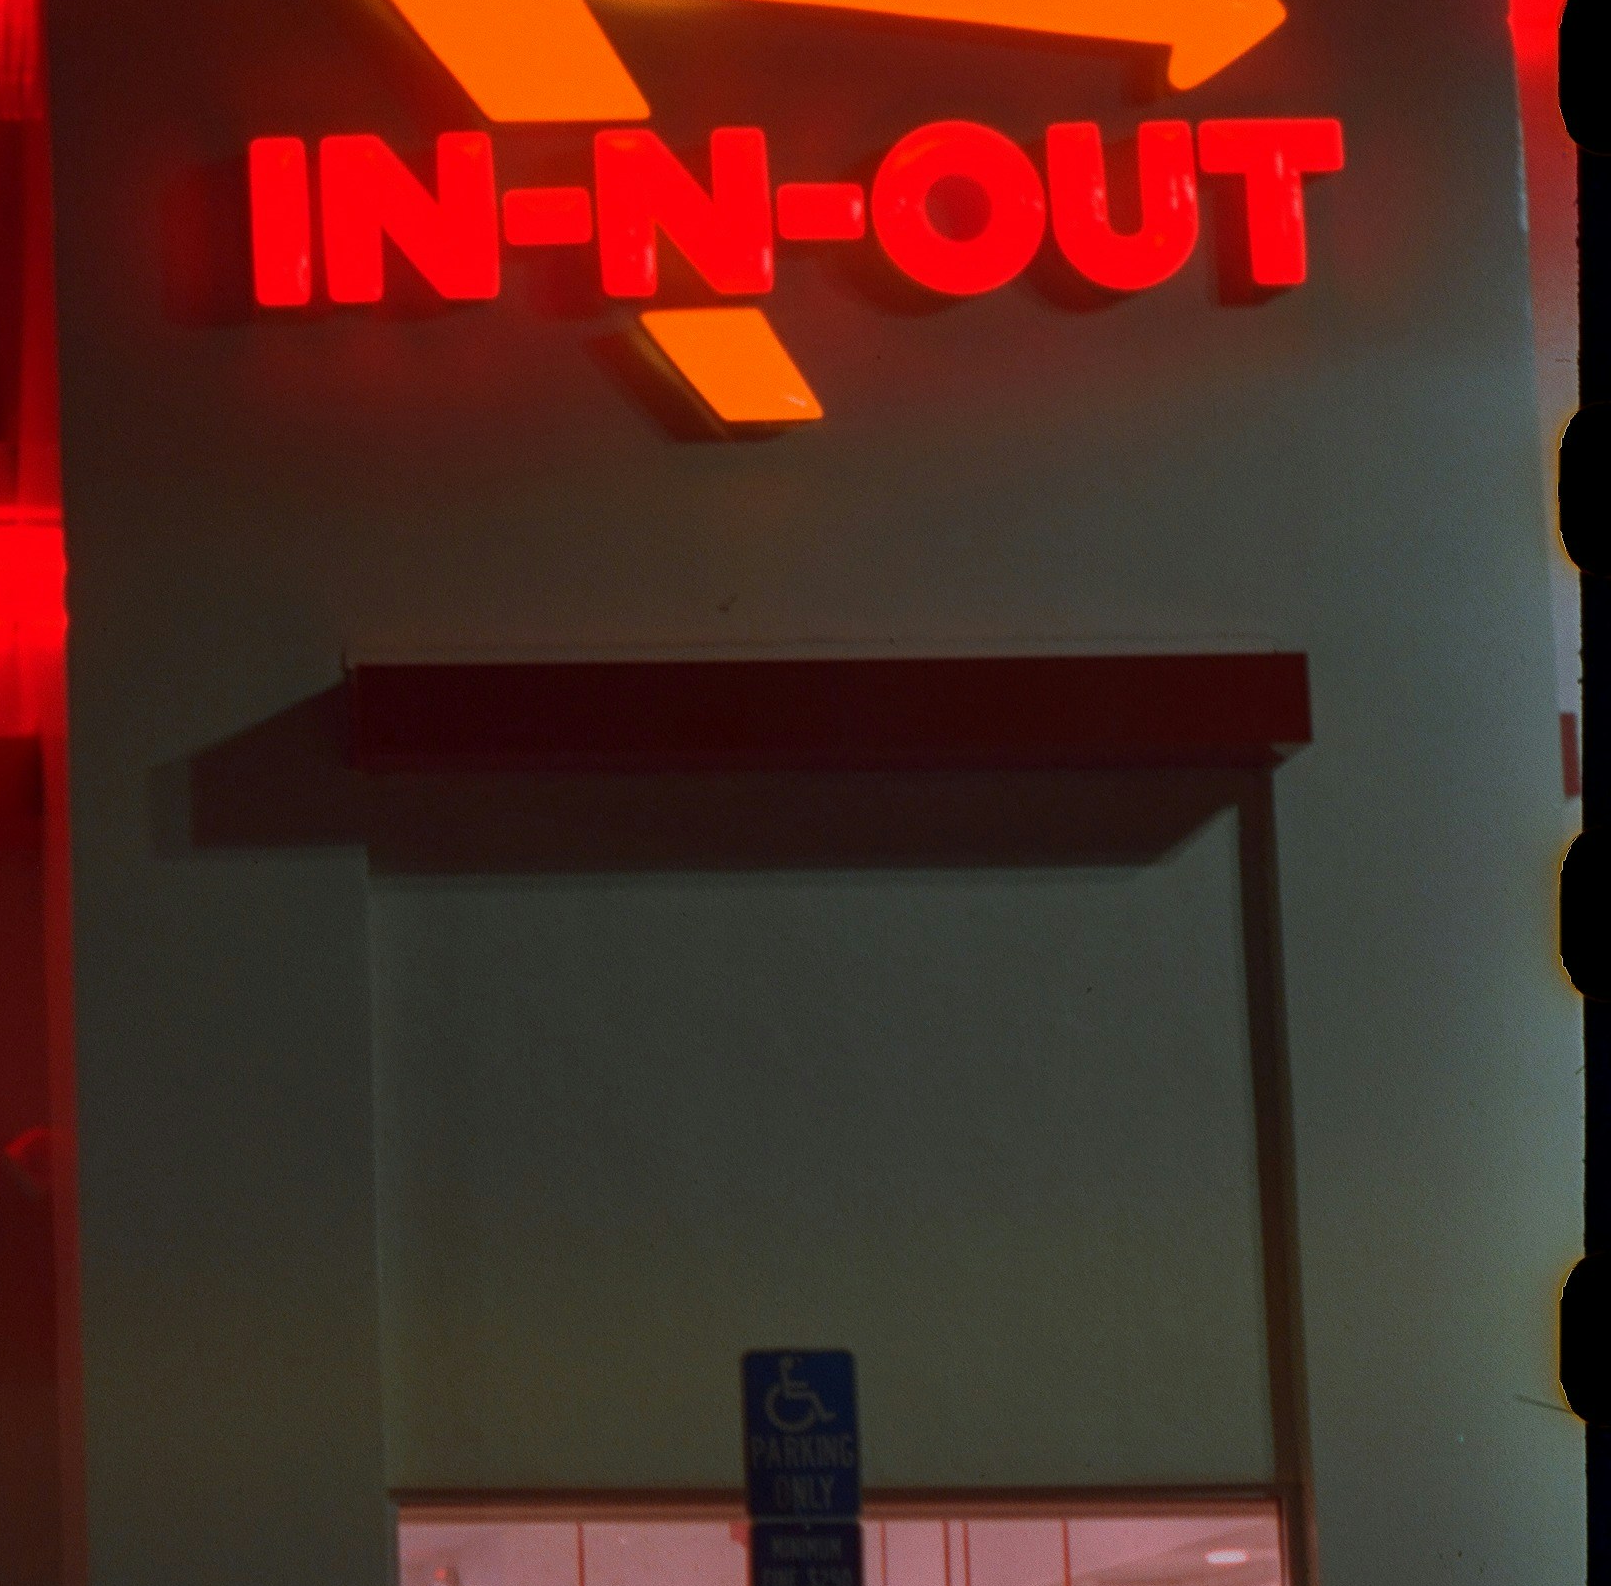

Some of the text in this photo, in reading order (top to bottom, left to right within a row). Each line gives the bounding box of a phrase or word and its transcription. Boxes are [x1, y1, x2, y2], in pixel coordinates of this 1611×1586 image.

[248, 117, 1345, 307] IN-N-OUT
[751, 1433, 854, 1468] PARKING
[773, 1474, 835, 1509] ONLY
